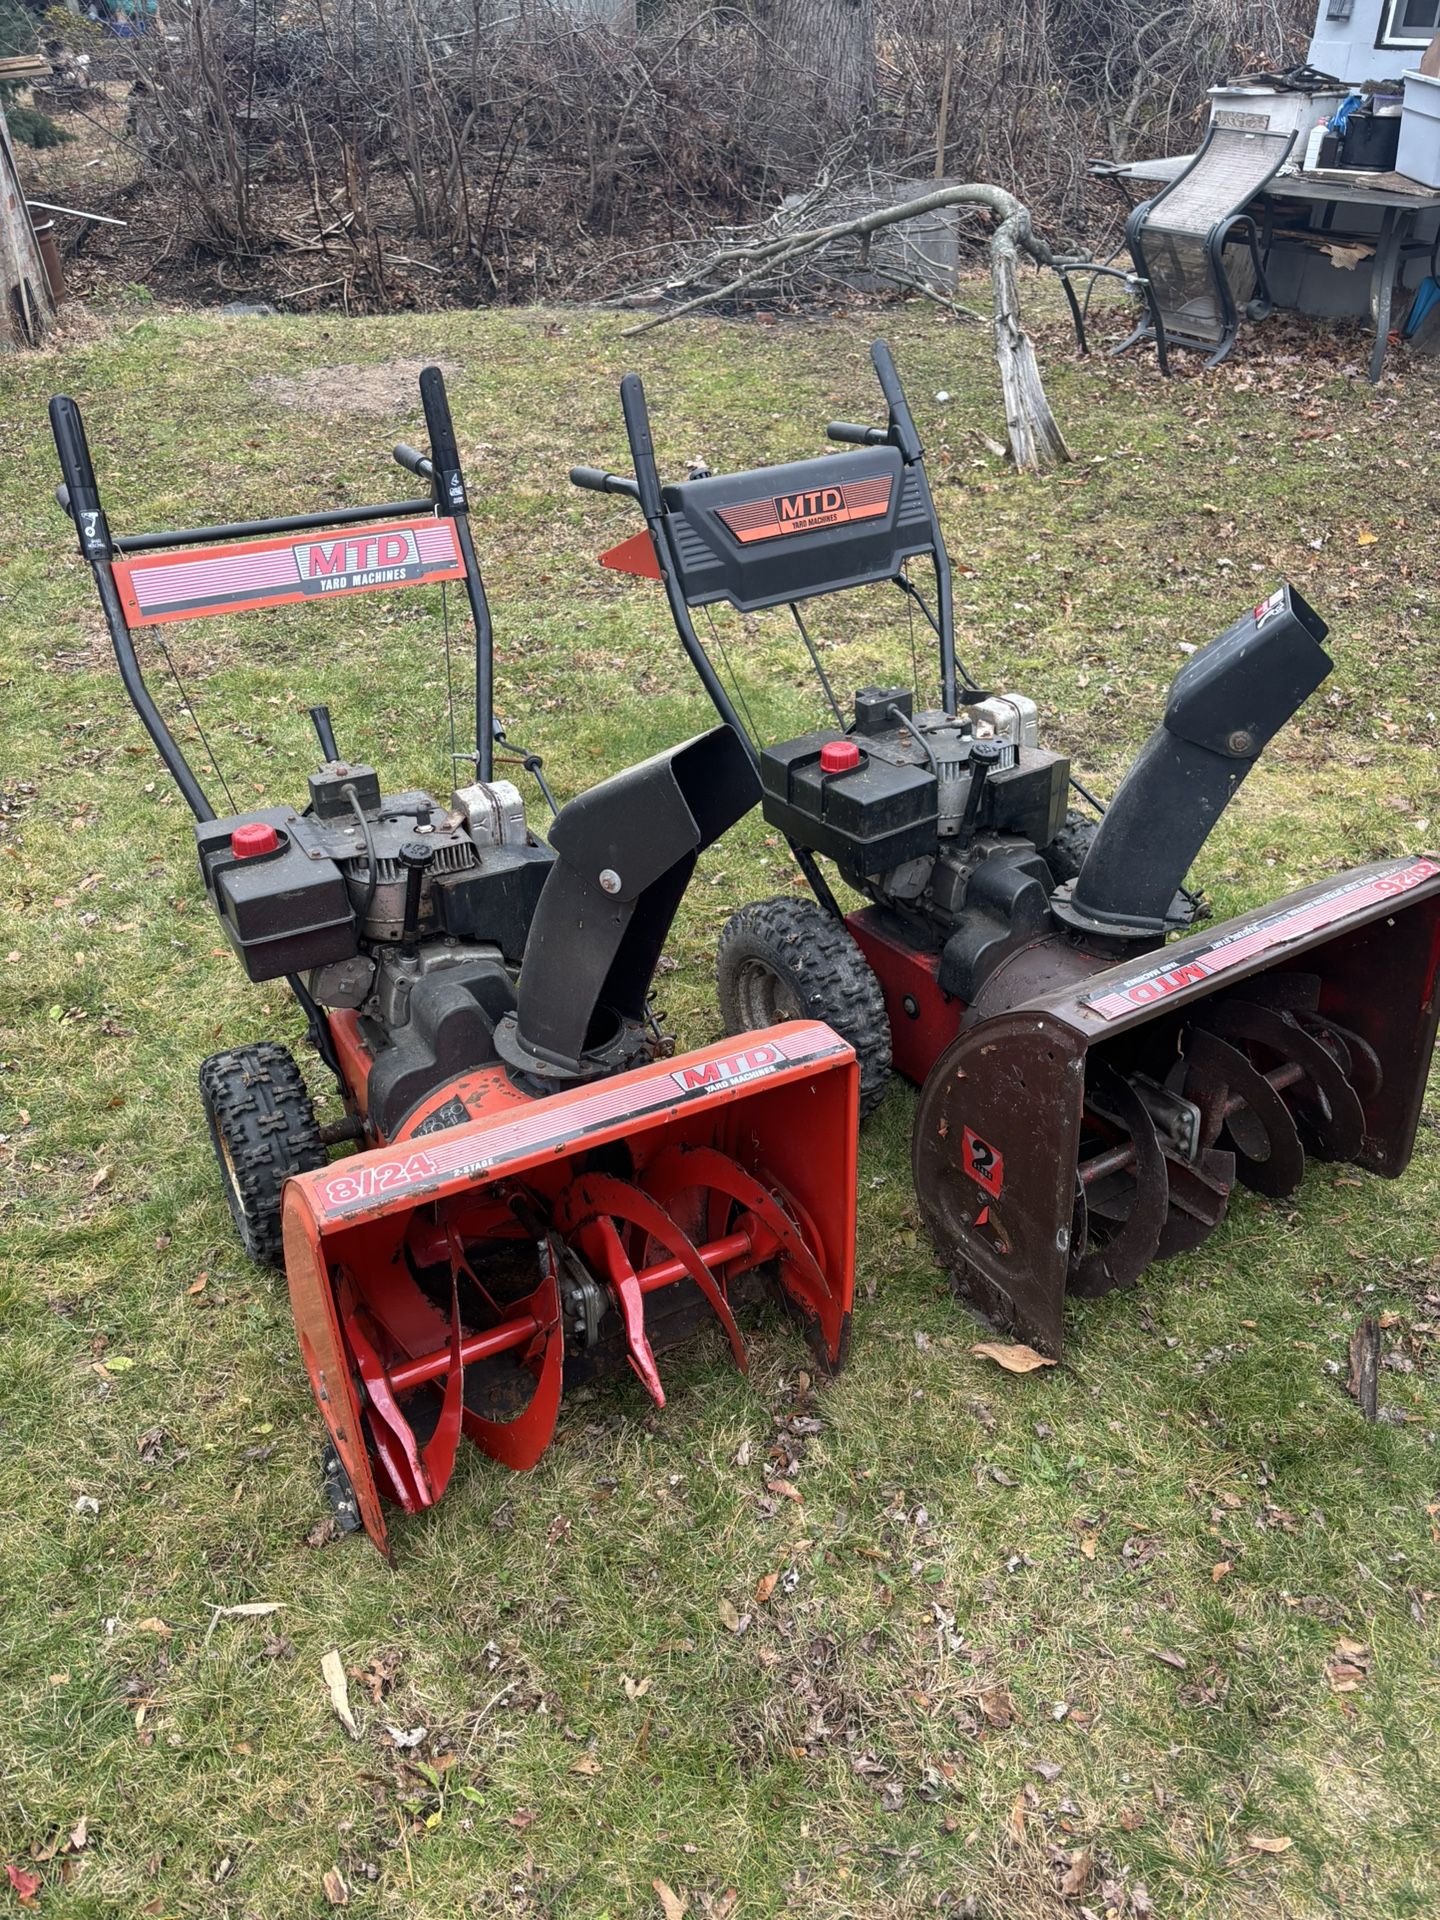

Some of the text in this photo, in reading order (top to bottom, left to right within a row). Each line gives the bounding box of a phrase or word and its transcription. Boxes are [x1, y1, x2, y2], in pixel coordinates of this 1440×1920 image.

[781, 489, 841, 520] MTD
[792, 513, 838, 529] YARD MACHINES
[308, 534, 409, 577] MTD
[320, 568, 407, 592] YARD MACHINES
[1123, 961, 1181, 988] YARD MACHINES
[1129, 963, 1208, 1003] MTD
[682, 1047, 777, 1090] MTD
[705, 1065, 777, 1094] YARD MACHINES
[453, 1157, 494, 1178] 2-STAGE
[972, 1139, 994, 1176] 2
[325, 1151, 438, 1204] 8/24
